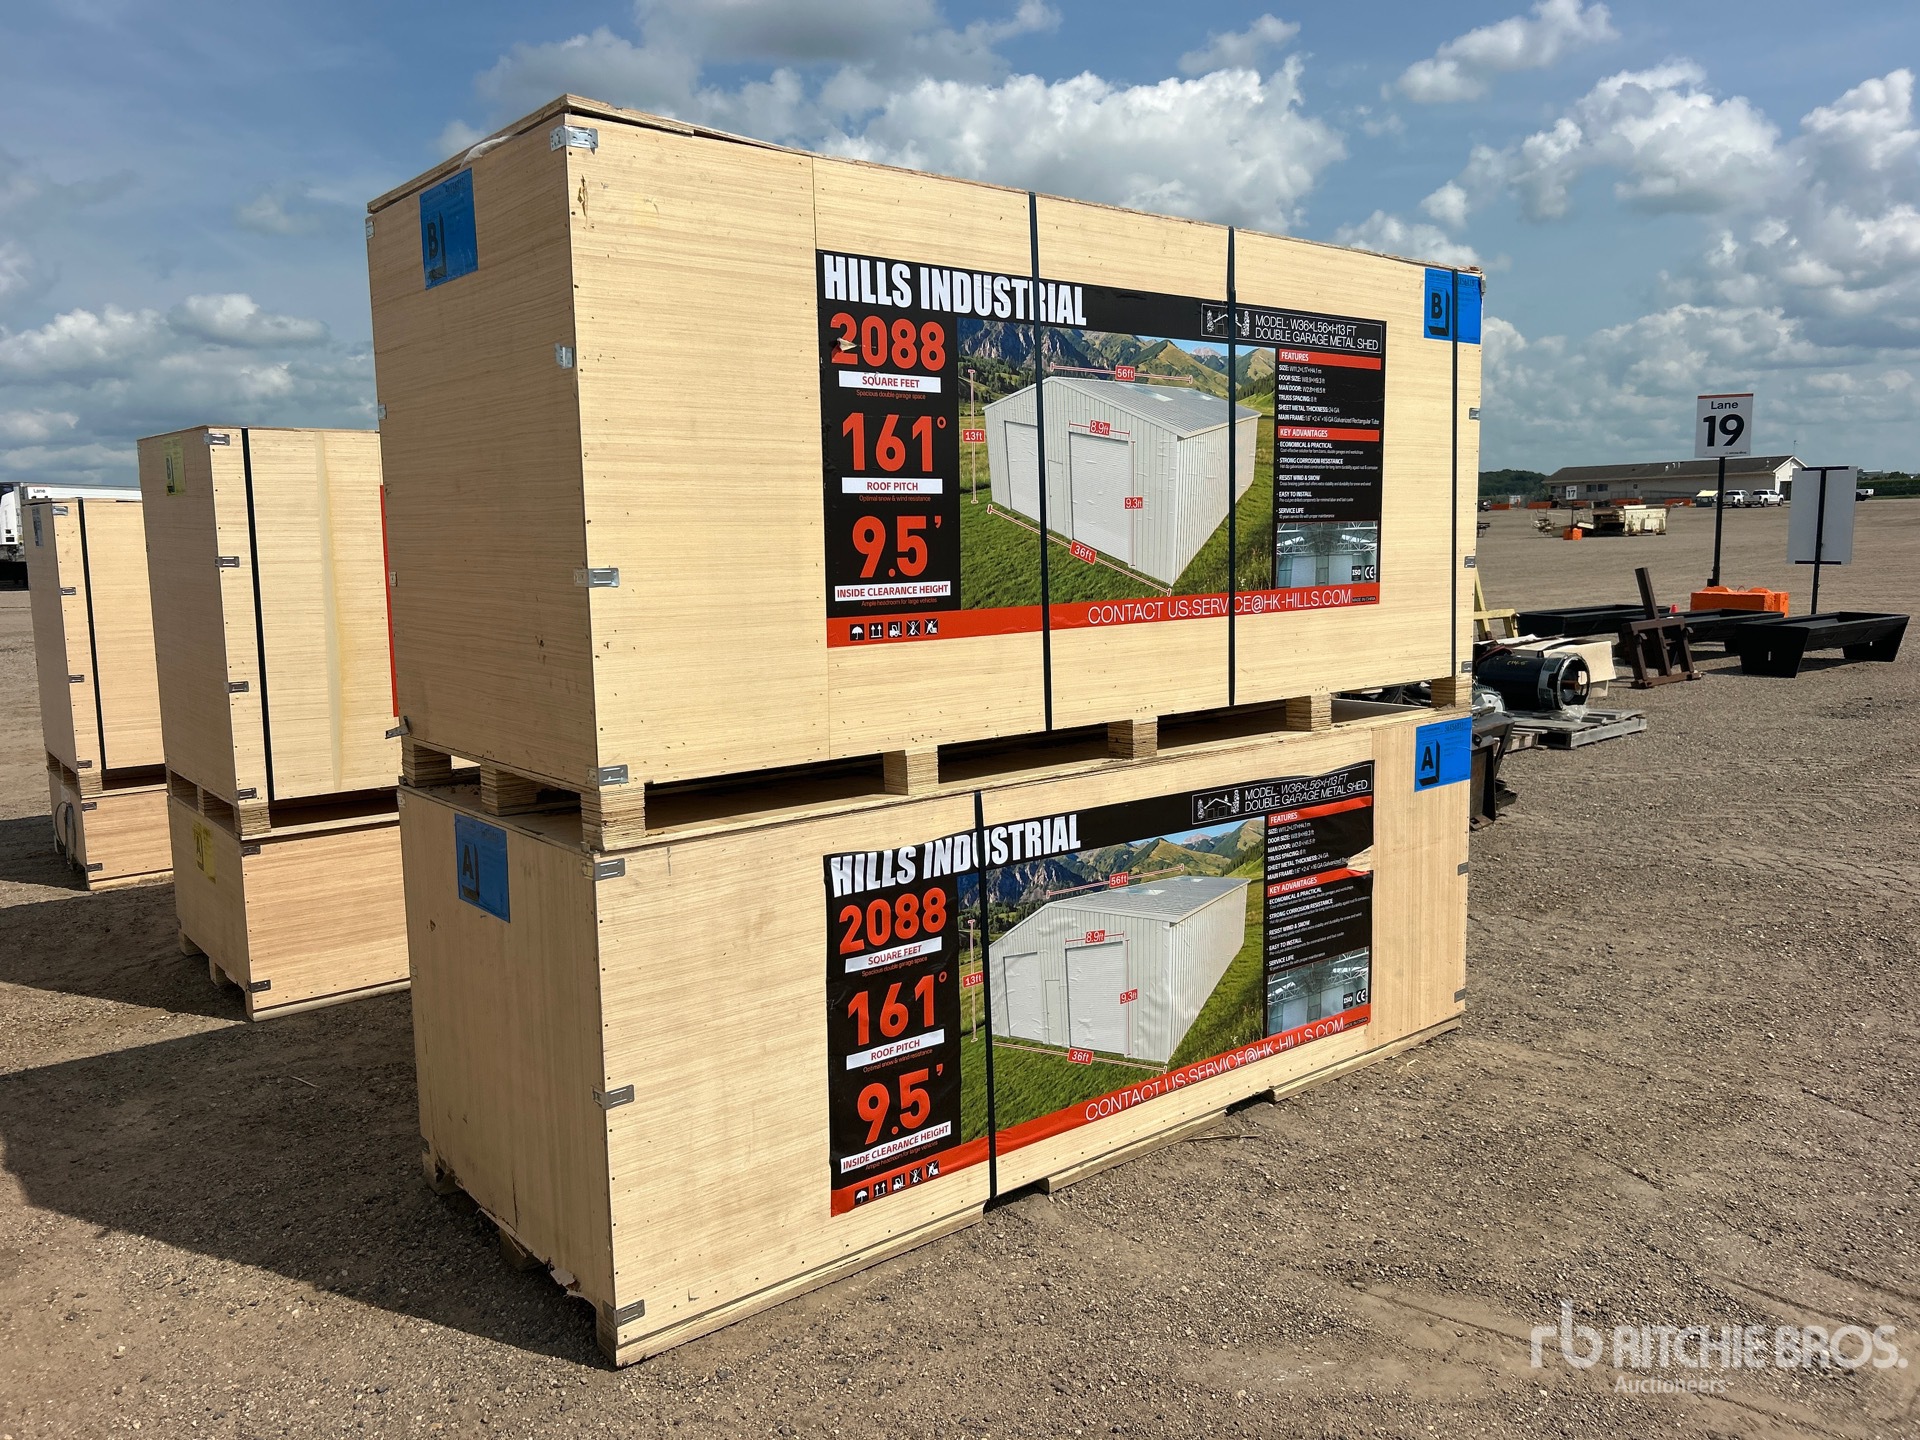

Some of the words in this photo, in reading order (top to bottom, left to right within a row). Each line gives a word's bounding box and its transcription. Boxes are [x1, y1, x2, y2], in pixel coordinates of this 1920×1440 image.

[427, 221, 439, 260] B
[823, 254, 912, 309] HILLS
[919, 266, 1087, 327] INDUSTRIAL
[1431, 292, 1443, 320] B
[1255, 314, 1289, 329] MODEL:
[1346, 325, 1357, 336] FT
[830, 312, 946, 372] 2088
[1255, 327, 1291, 341] DOUBLE
[1292, 331, 1329, 346] GARAGE
[1329, 335, 1356, 348] METAL
[1357, 338, 1379, 351] SHED
[1281, 351, 1309, 362] FEATURES
[1117, 368, 1135, 379] 56ft
[862, 375, 899, 387] SQUARE
[900, 378, 920, 388] FEET
[856, 389, 878, 398] Spacious
[1278, 403, 1292, 411] SHEET
[1710, 401, 1739, 410] Lane
[1090, 421, 1110, 434] 8.9ft
[1292, 429, 1328, 438] ADVANTAGES
[1703, 413, 1745, 447] 19
[965, 431, 983, 441] 13ft
[866, 481, 891, 491] ROOF
[893, 481, 919, 491] PITCH
[859, 494, 878, 502] Optimal
[1567, 489, 1576, 498] 17
[1125, 497, 1143, 508] 9.3ft
[1074, 544, 1093, 562] 36ft
[1365, 566, 1374, 579] CE
[837, 588, 866, 598] INSIDE
[867, 586, 918, 597] CLEARANCE
[919, 584, 949, 594] HEIGHT
[861, 600, 877, 608] Ample
[1087, 601, 1164, 625] CONTACT
[1167, 588, 1351, 618] US:SERVCE@HK-HILLS.COM
[1420, 745, 1434, 772] A
[1338, 773, 1349, 784] FT
[1245, 796, 1280, 812] DOUBLE
[1281, 790, 1320, 805] GARAGE
[1320, 785, 1346, 799] METAL
[1346, 779, 1368, 792] SHED
[1270, 812, 1298, 824] FEATURES
[462, 844, 475, 881] A
[830, 845, 917, 898] HILLS
[922, 814, 1082, 880] INDUSTRIAL
[1111, 874, 1128, 886] 56ft
[1269, 886, 1281, 895] KEY
[1281, 877, 1318, 892] ADVANTAGES
[1269, 893, 1297, 905] ECONOMICAL
[1300, 887, 1322, 897] PRACTICAL
[1269, 911, 1286, 920] STRONG
[1286, 904, 1310, 915] CORROSION
[1310, 898, 1334, 909] RESISTANCE
[839, 887, 947, 955] 2088
[1086, 930, 1105, 943] 8.9ft
[1269, 943, 1280, 951] EASY
[867, 949, 902, 966] SQUARE
[903, 945, 922, 957] FEET
[1268, 956, 1286, 967] SERVICE
[1285, 954, 1295, 962] LIFE
[861, 967, 883, 977] Spacious
[883, 963, 899, 972] double
[965, 974, 982, 986] 13ft
[1120, 990, 1138, 1002] 9.3ft
[1356, 989, 1366, 1003] CE
[870, 1046, 895, 1061] ROOF
[896, 1039, 920, 1054] PITCH
[1071, 1050, 1090, 1062] 36ft
[862, 1065, 882, 1073] Optimal
[1085, 1080, 1162, 1121] CONTACT
[843, 1153, 870, 1170] INSIDE
[871, 1135, 919, 1159] CLEARANCE
[920, 1124, 949, 1142] HEIGHT
